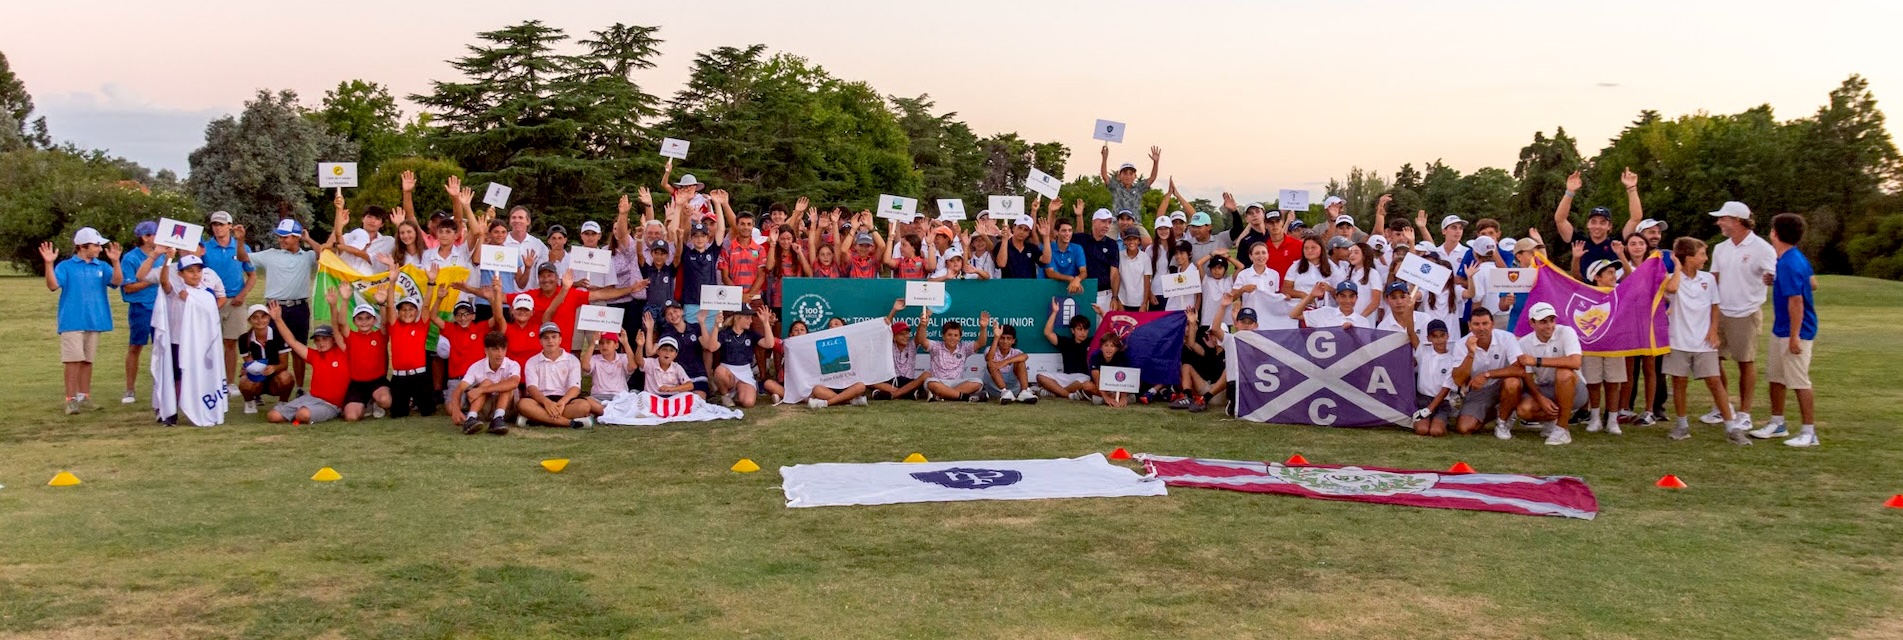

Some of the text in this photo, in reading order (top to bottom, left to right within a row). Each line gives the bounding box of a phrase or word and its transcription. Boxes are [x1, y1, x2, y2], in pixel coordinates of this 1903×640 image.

[1306, 331, 1336, 359] G
[1254, 364, 1280, 392] S
[1366, 366, 1398, 395] A
[1308, 398, 1337, 426] C
